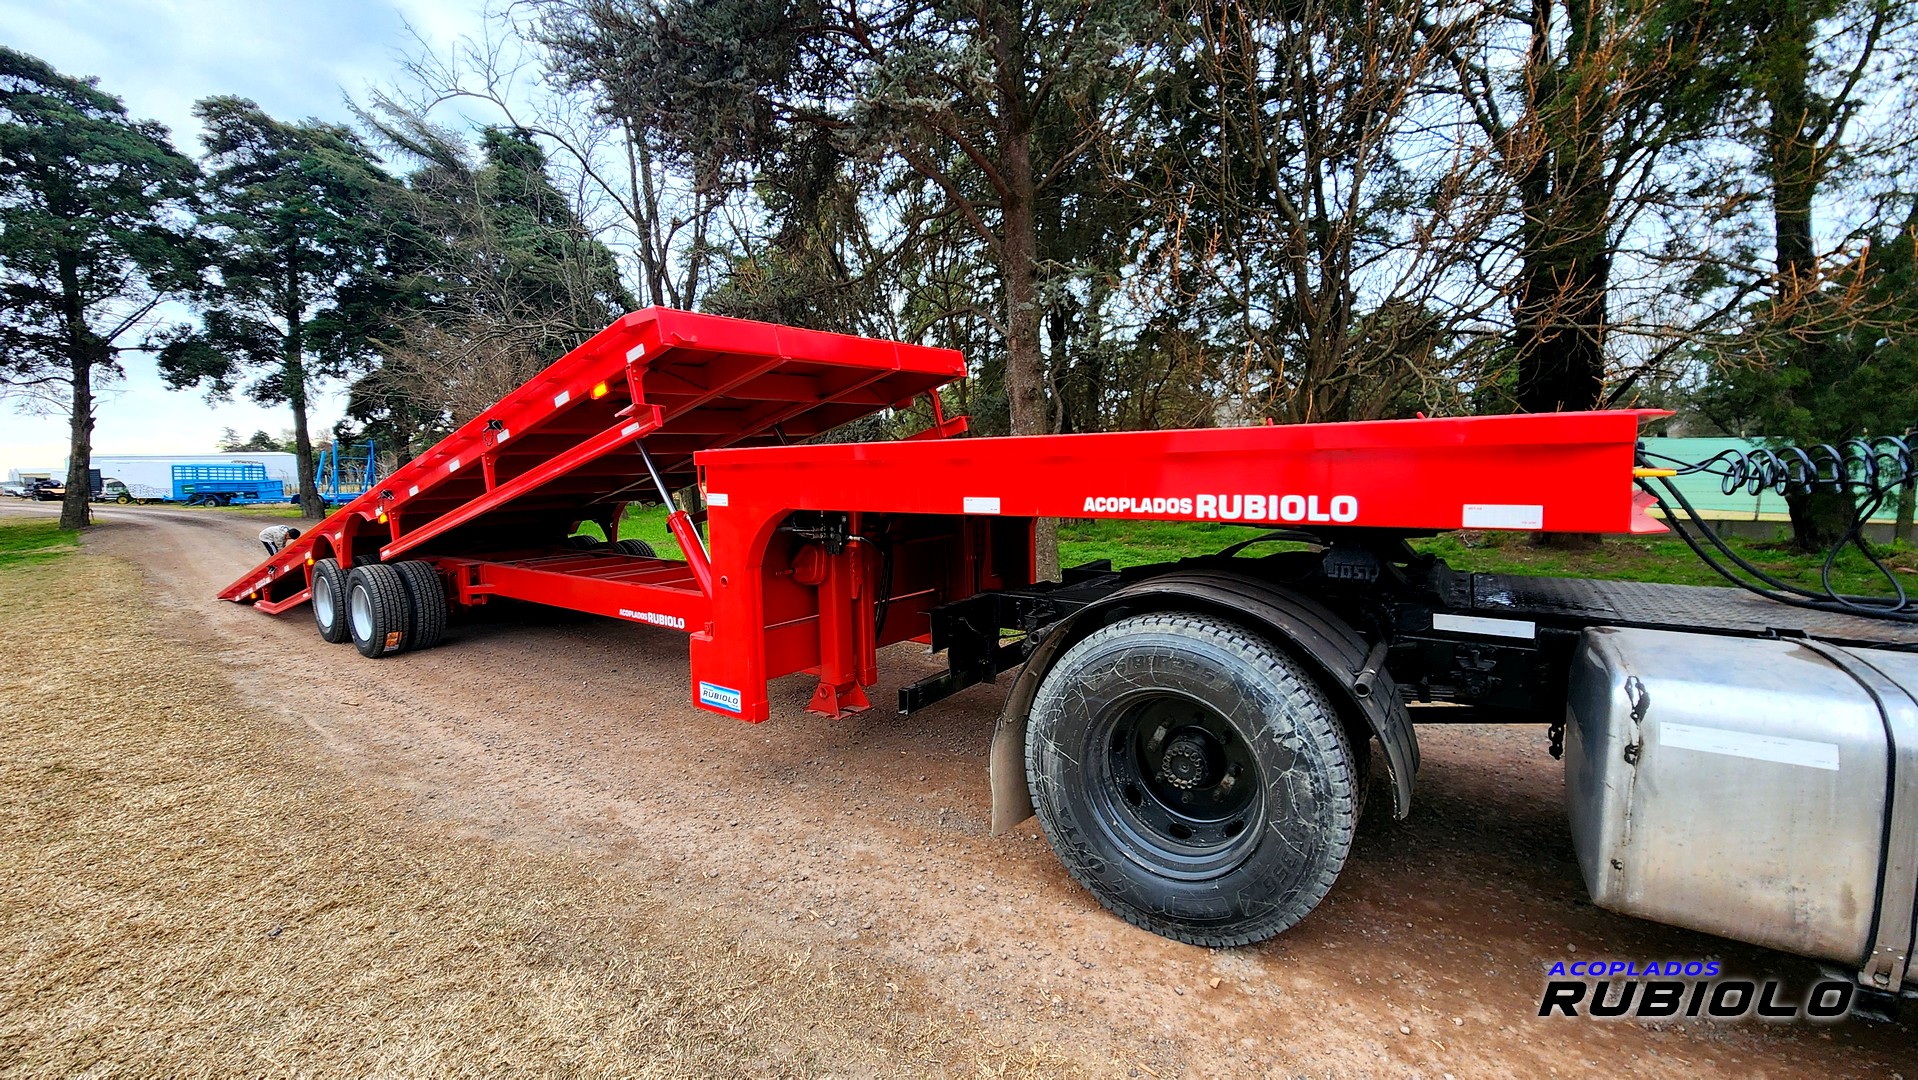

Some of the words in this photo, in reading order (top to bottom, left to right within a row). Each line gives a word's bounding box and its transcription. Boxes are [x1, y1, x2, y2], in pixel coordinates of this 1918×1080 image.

[1083, 497, 1192, 514] ACOPLADOS
[1196, 494, 1358, 522] RUBIOLO
[619, 609, 648, 620] ACOPLADOS
[648, 612, 685, 629] RUBIOLO
[702, 690, 739, 705] RUBIOLO
